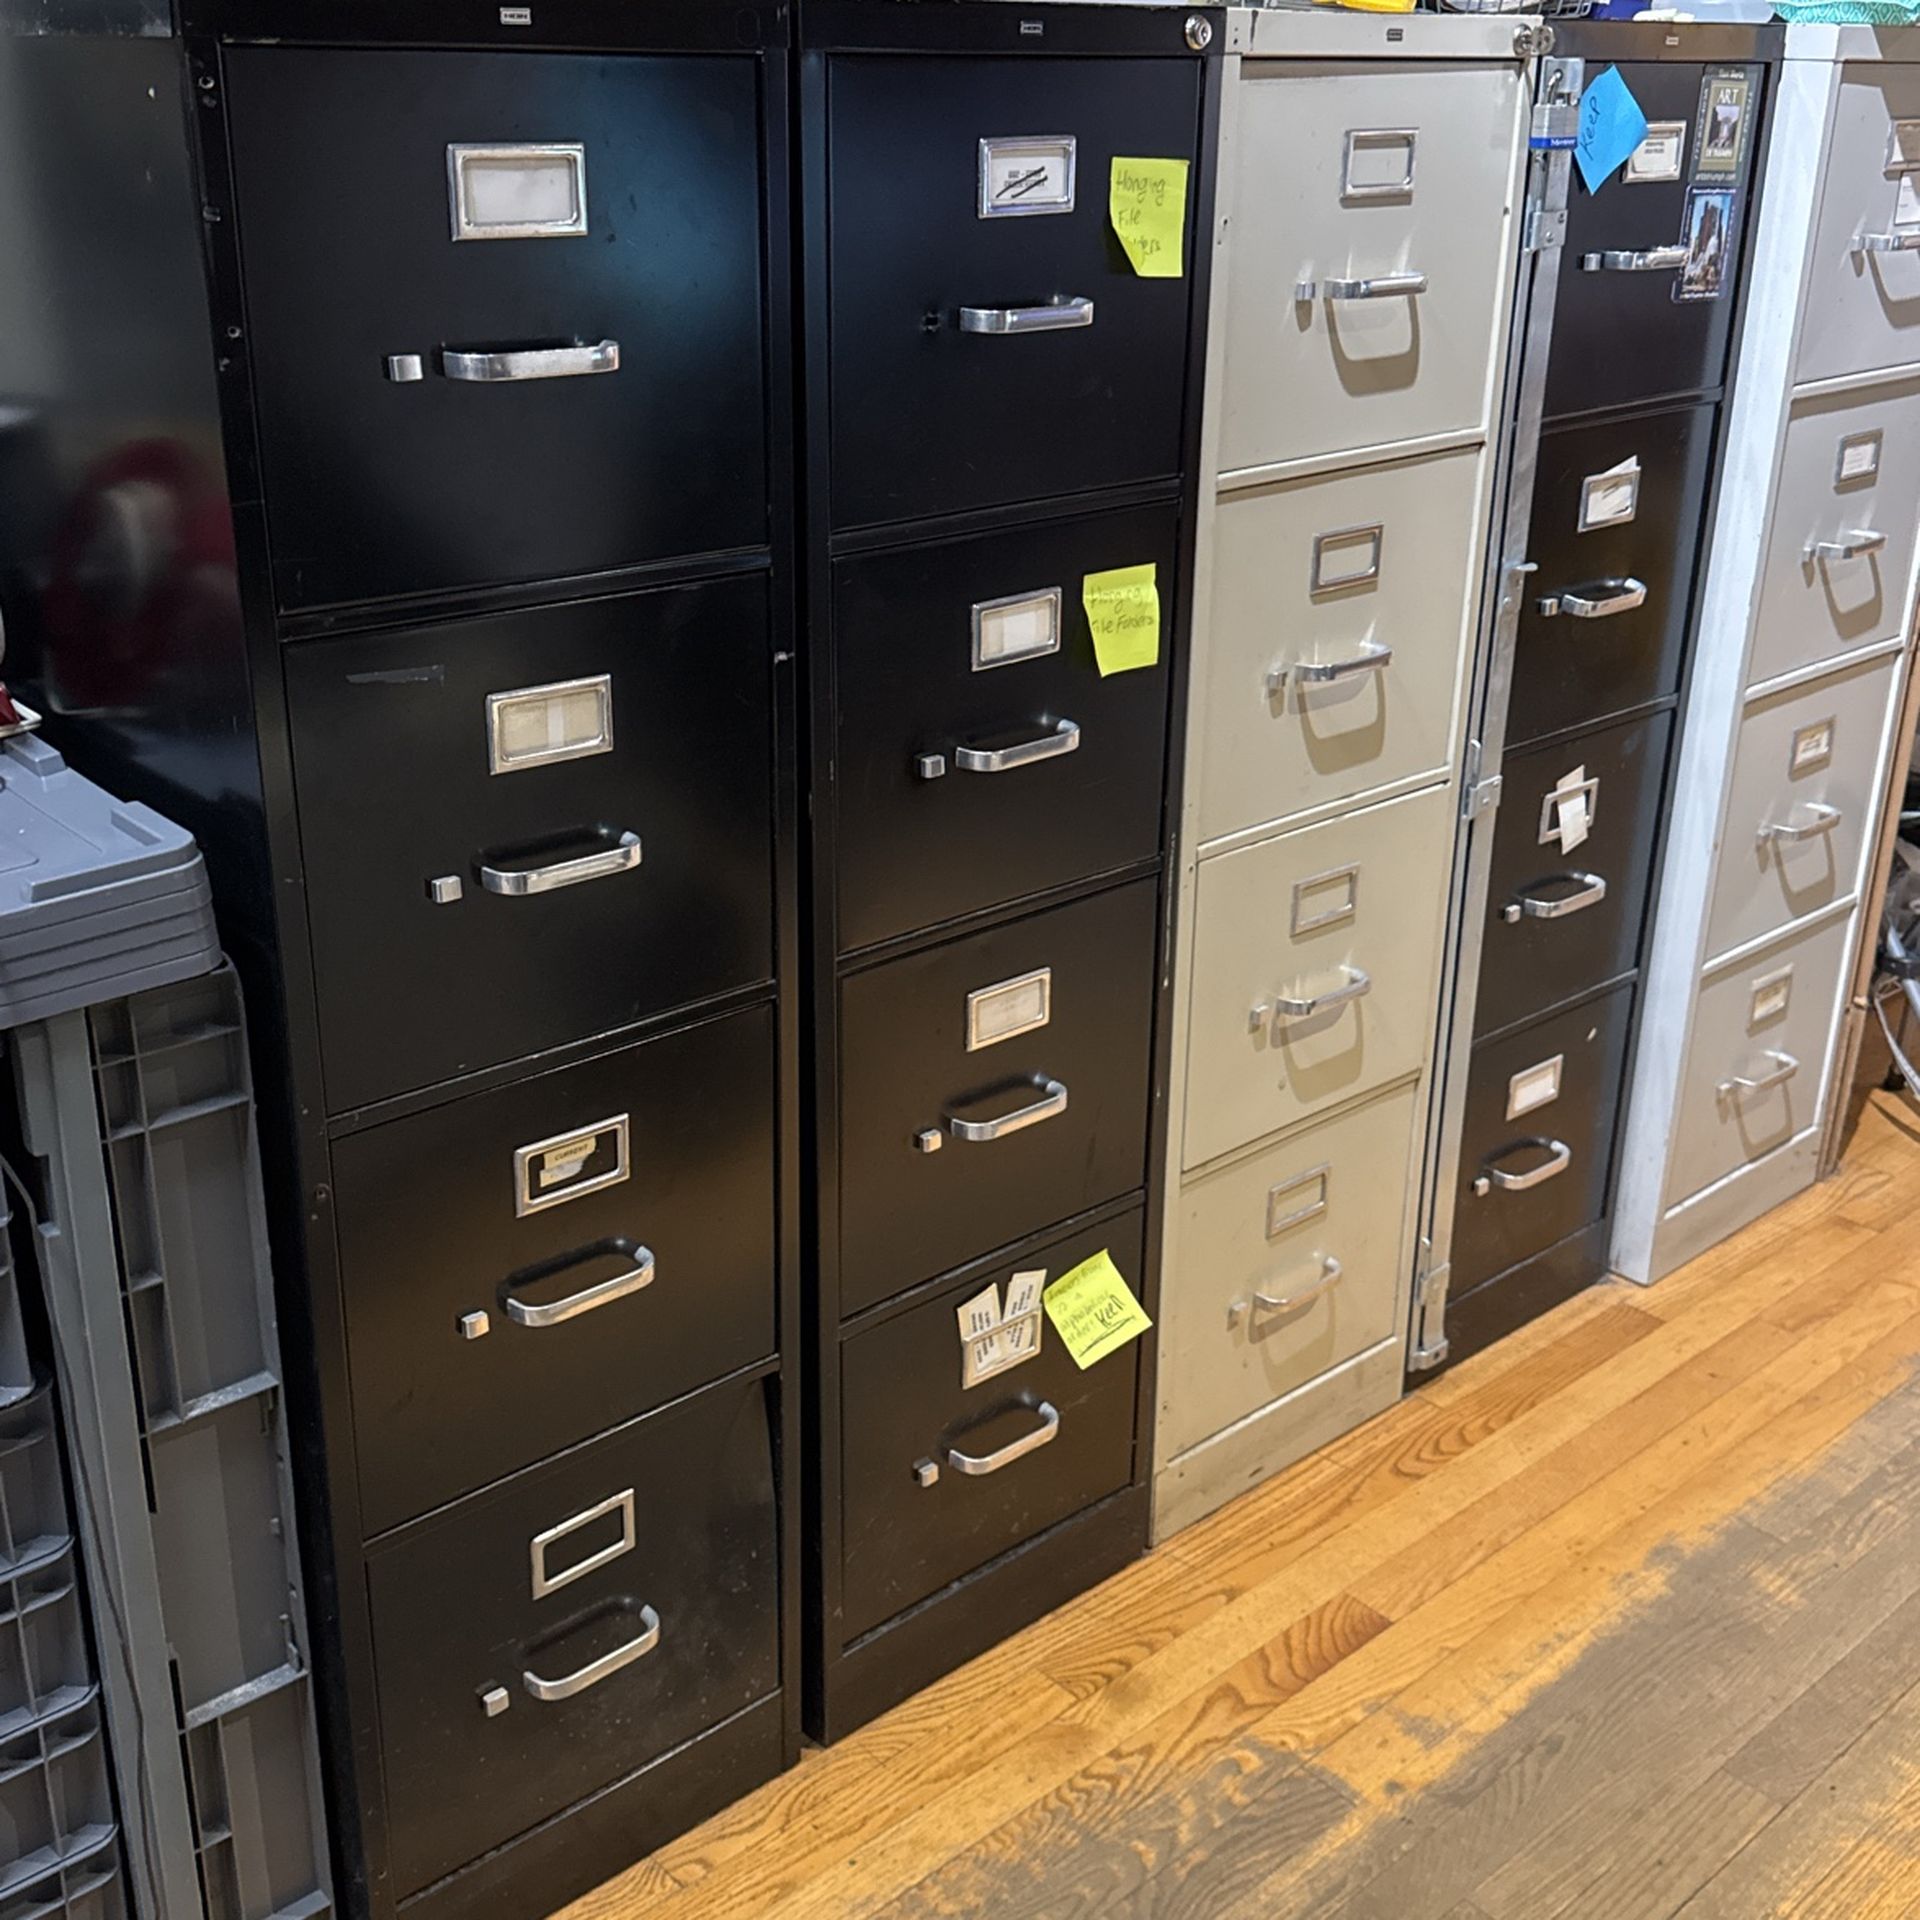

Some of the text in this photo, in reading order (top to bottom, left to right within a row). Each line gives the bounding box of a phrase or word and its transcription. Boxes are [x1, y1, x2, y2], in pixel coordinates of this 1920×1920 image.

[1717, 87, 1739, 104] ART
[1116, 170, 1166, 206] Hanging
[1118, 207, 1141, 228] File
